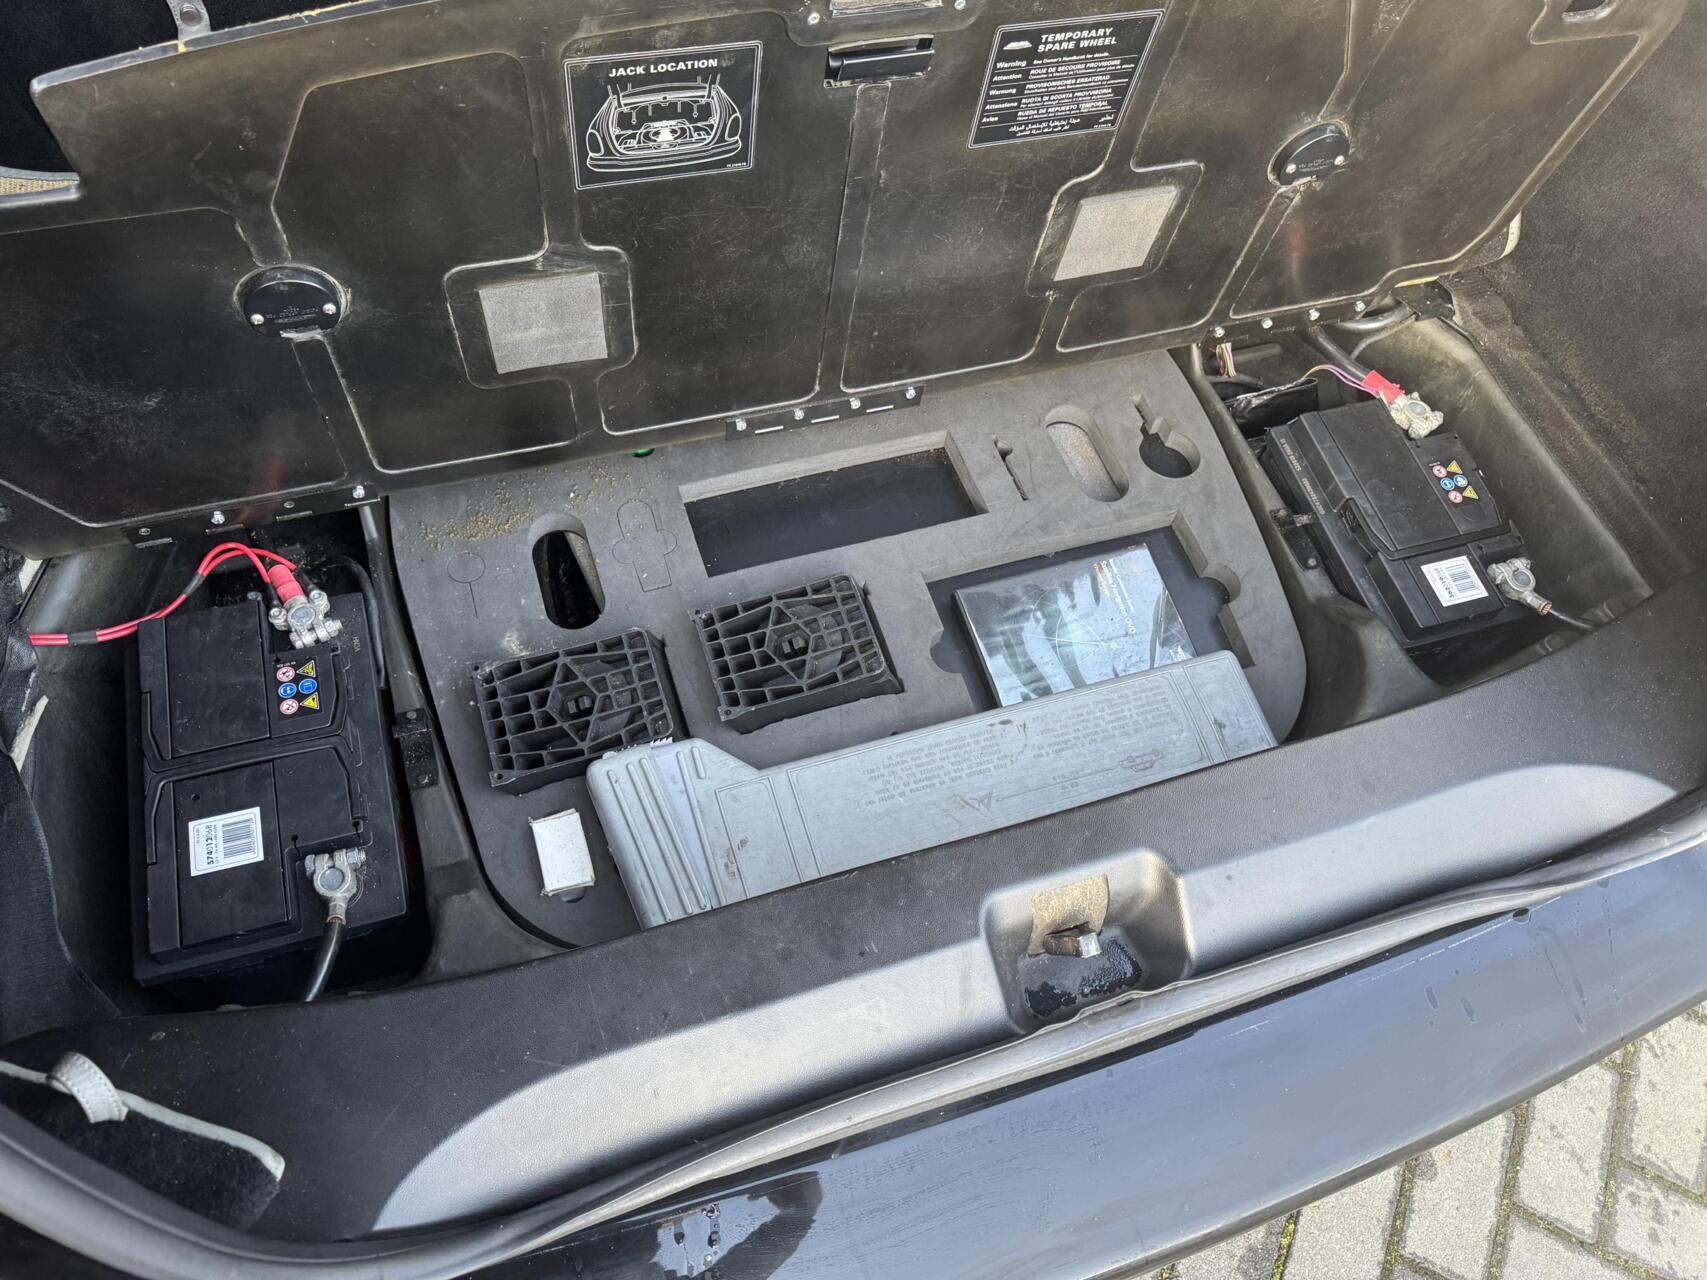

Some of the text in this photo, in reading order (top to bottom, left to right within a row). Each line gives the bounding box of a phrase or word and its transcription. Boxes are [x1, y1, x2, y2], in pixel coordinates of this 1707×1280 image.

[1041, 27, 1114, 43] TEMPORARY
[1037, 36, 1117, 53] SPARE WHEEL
[608, 58, 718, 77] JACK LOCATION
[996, 60, 1027, 69] Warning
[1030, 67, 1047, 75] ROUE
[1057, 64, 1086, 72] SECOURS
[992, 73, 1022, 81] Attention
[989, 88, 1017, 96] Warnung
[985, 101, 1018, 111] Attenzione
[1021, 96, 1042, 105] RUOTA
[1017, 108, 1038, 117] RUEDA
[1047, 104, 1077, 113] REPUESTO
[204, 824, 214, 866] 574012068
